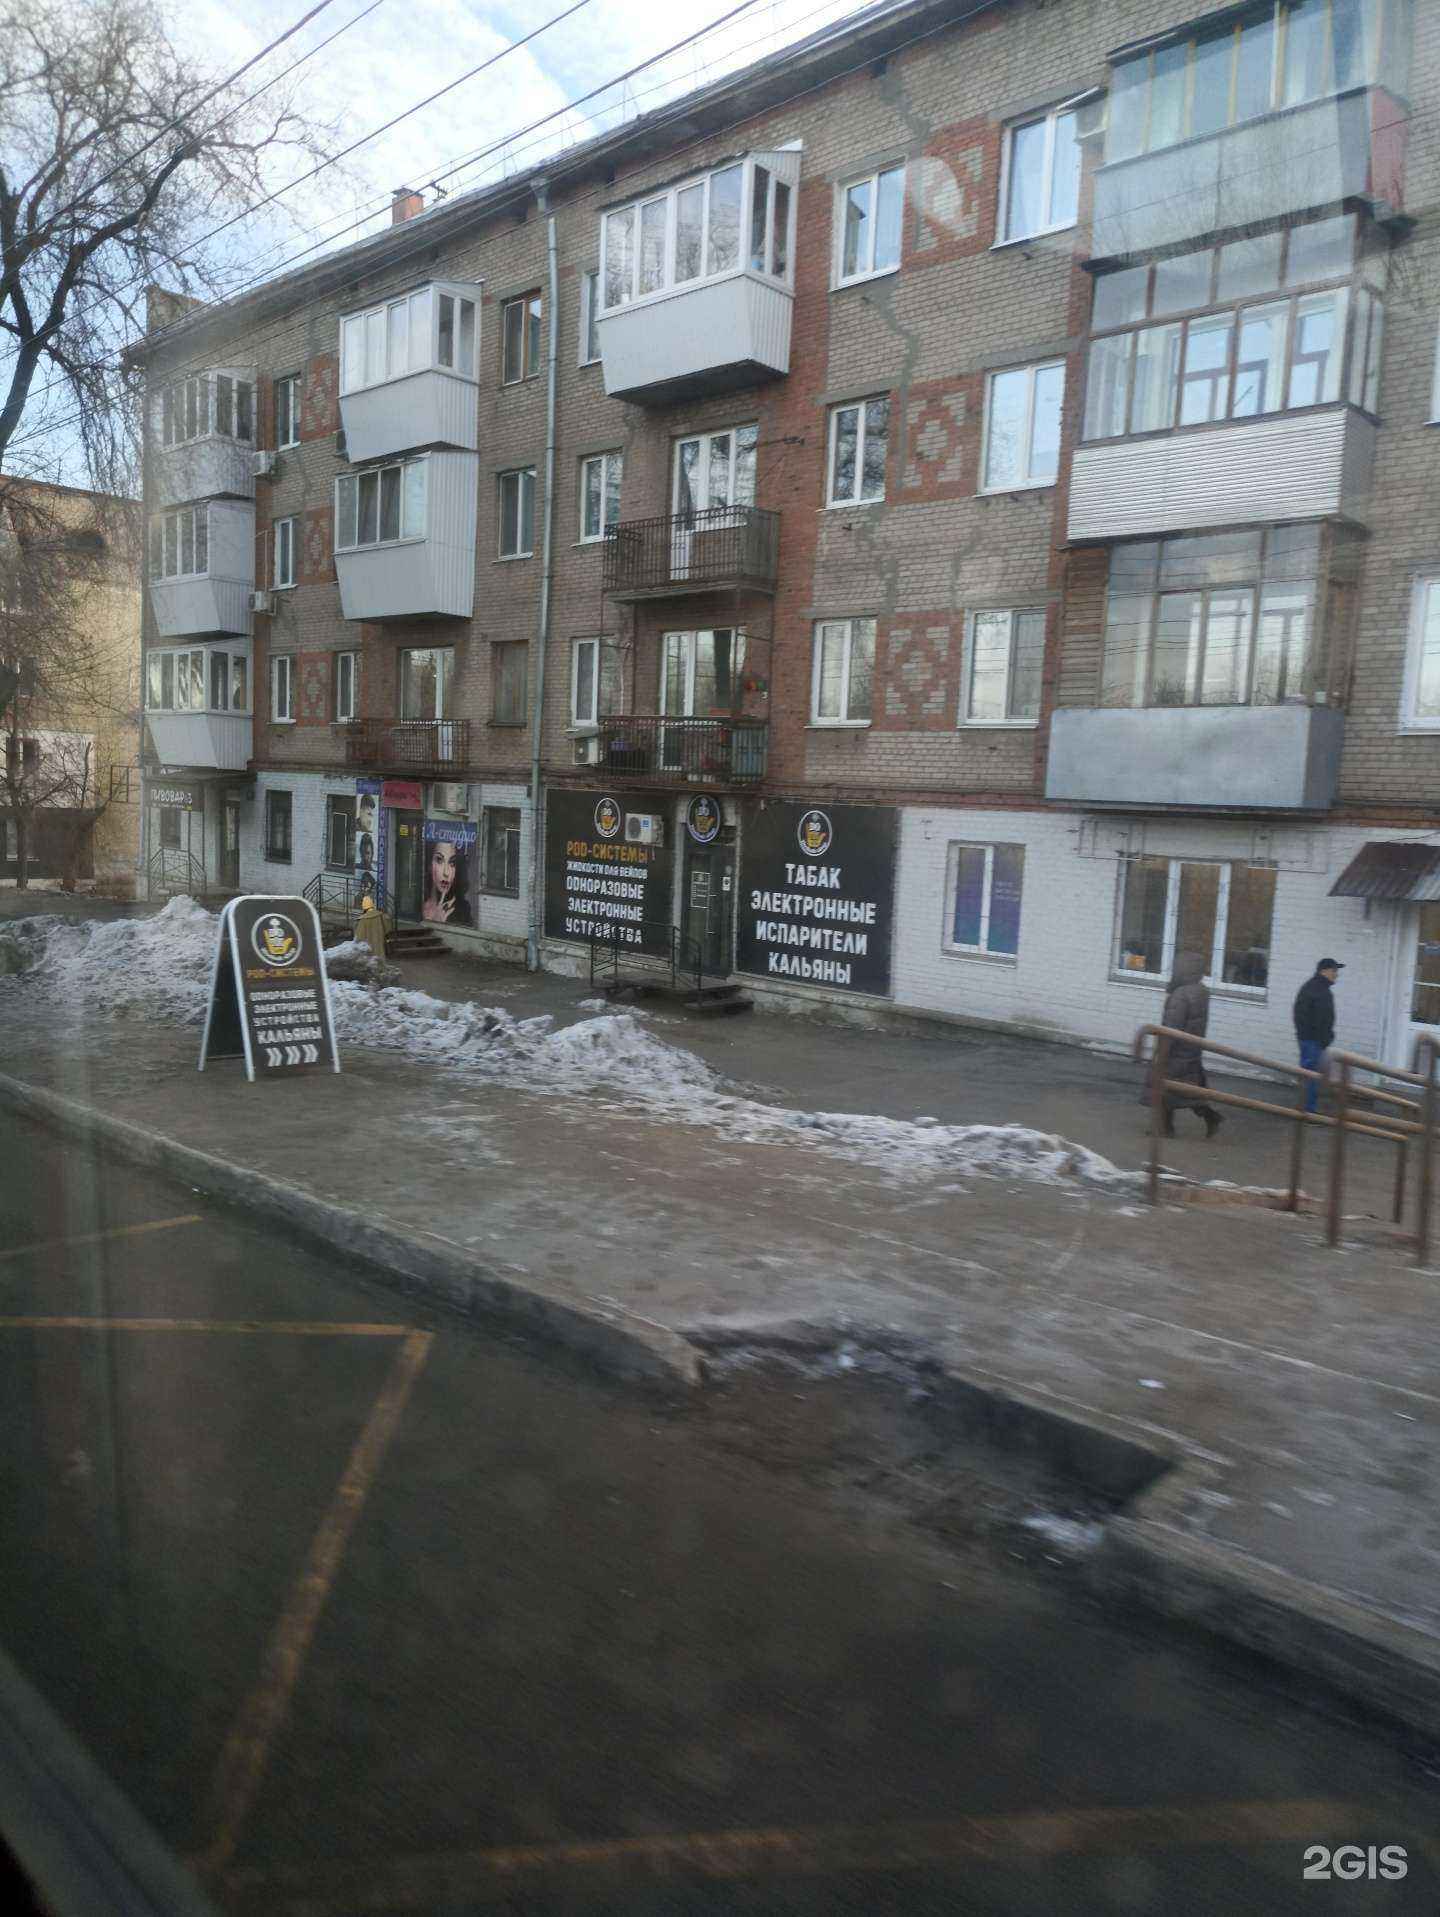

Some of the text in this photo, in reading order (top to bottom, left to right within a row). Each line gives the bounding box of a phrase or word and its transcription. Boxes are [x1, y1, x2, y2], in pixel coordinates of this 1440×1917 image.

[566, 875, 645, 900] ОДНОРАЗОВЫЕ
[785, 863, 842, 889] ТАБАК
[567, 897, 643, 922] ЭЛЕКТРОННЫЕ
[751, 890, 878, 925] ЭЛЕКТРОННЫЕ
[756, 920, 868, 956] ИСПАРИТЕЛИ
[768, 952, 851, 985] КАЛЬЯНЫ
[256, 1026, 322, 1044] КАЛЬЯНЫ
